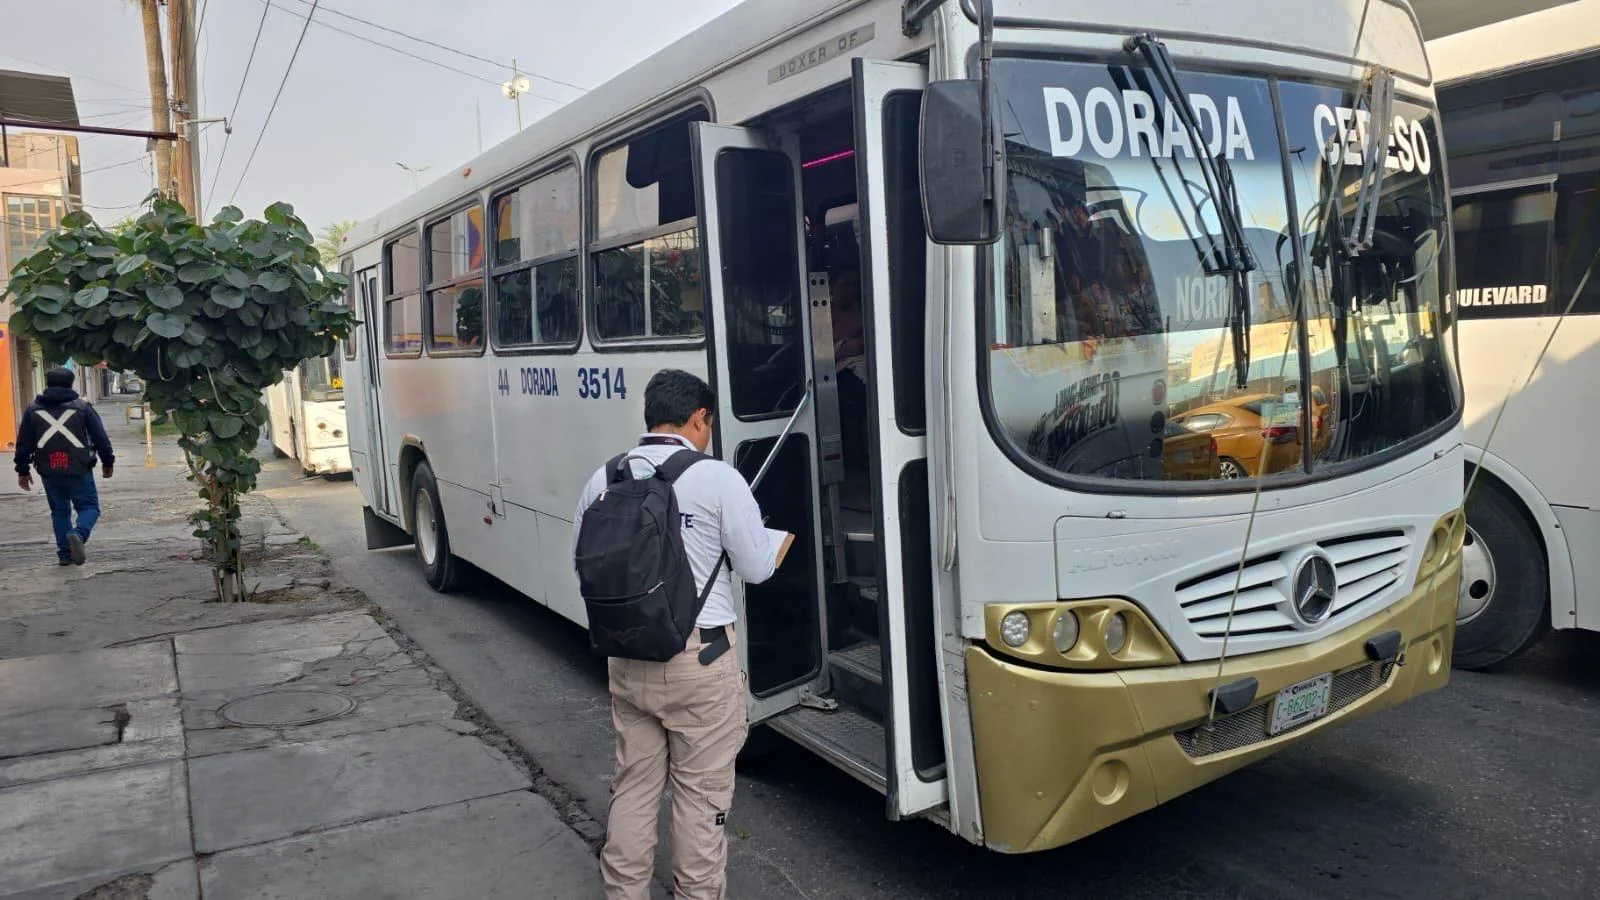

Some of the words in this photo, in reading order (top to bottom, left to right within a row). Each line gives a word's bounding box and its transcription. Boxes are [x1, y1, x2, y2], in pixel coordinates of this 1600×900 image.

[778, 46, 827, 77] BOXER
[838, 31, 859, 51] OF
[1042, 86, 1256, 161] DORADA
[1445, 284, 1548, 314] ULEVARD
[498, 368, 510, 396] 44
[520, 367, 559, 396] DORADA
[577, 367, 627, 399] 3514
